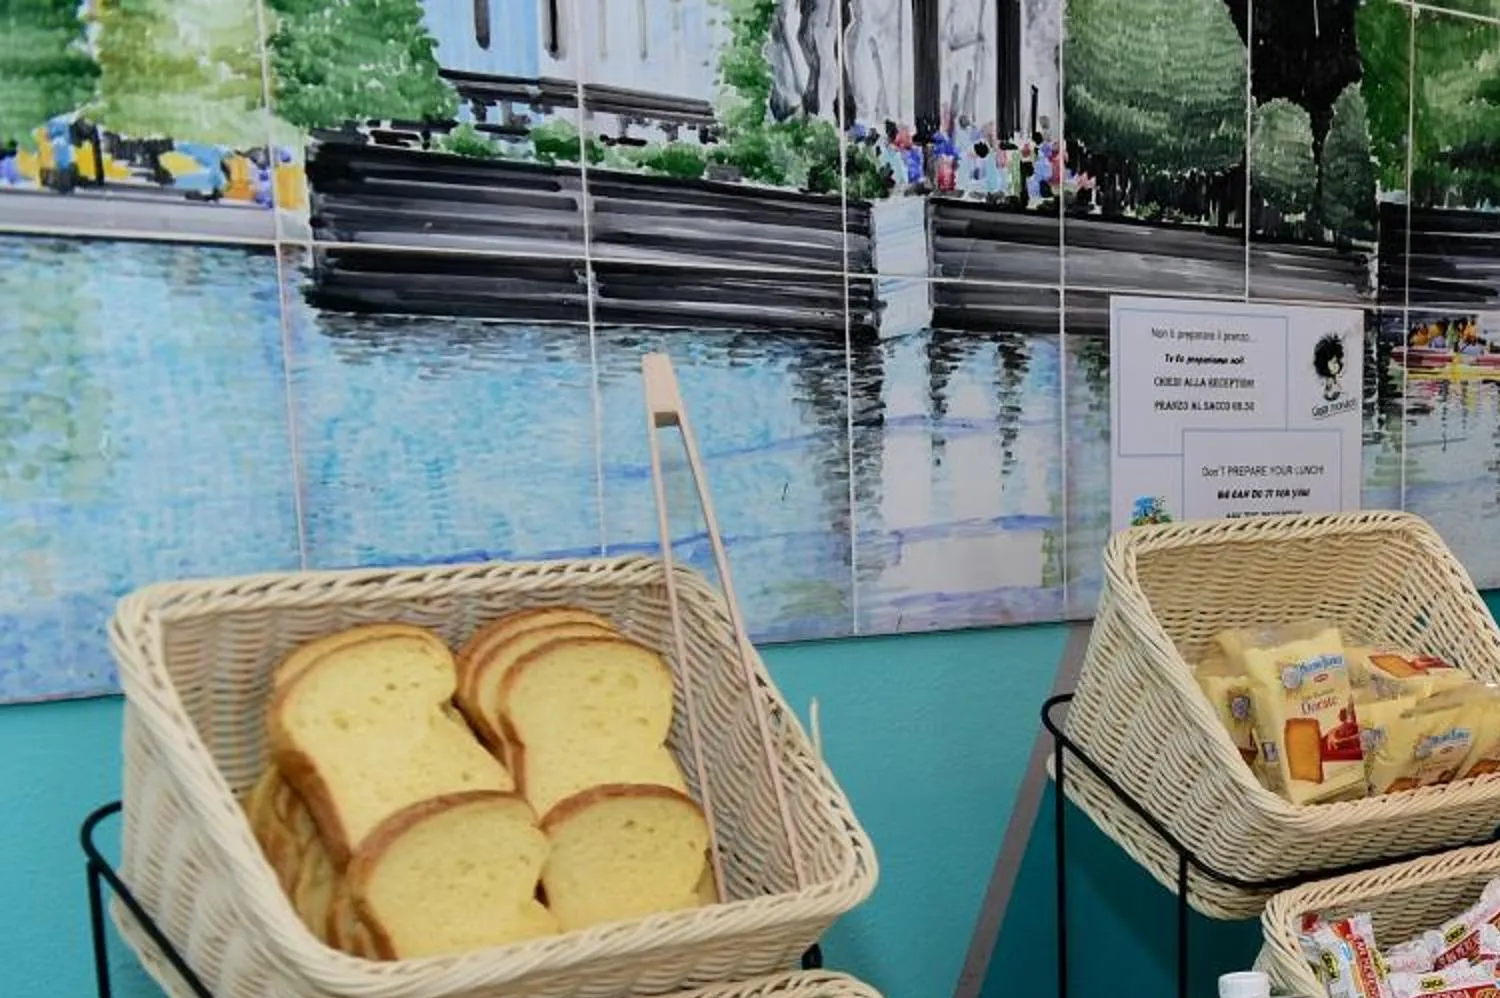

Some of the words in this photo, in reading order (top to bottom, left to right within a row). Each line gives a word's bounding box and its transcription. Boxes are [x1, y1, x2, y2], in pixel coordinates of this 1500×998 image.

[1183, 378, 1206, 388] ALLA
[1154, 400, 1188, 411] PRANZO
[1227, 465, 1269, 477] PREPARE
[1270, 465, 1293, 476] YOUR
[1231, 489, 1251, 499] CAN
[1252, 489, 1263, 499] DO
